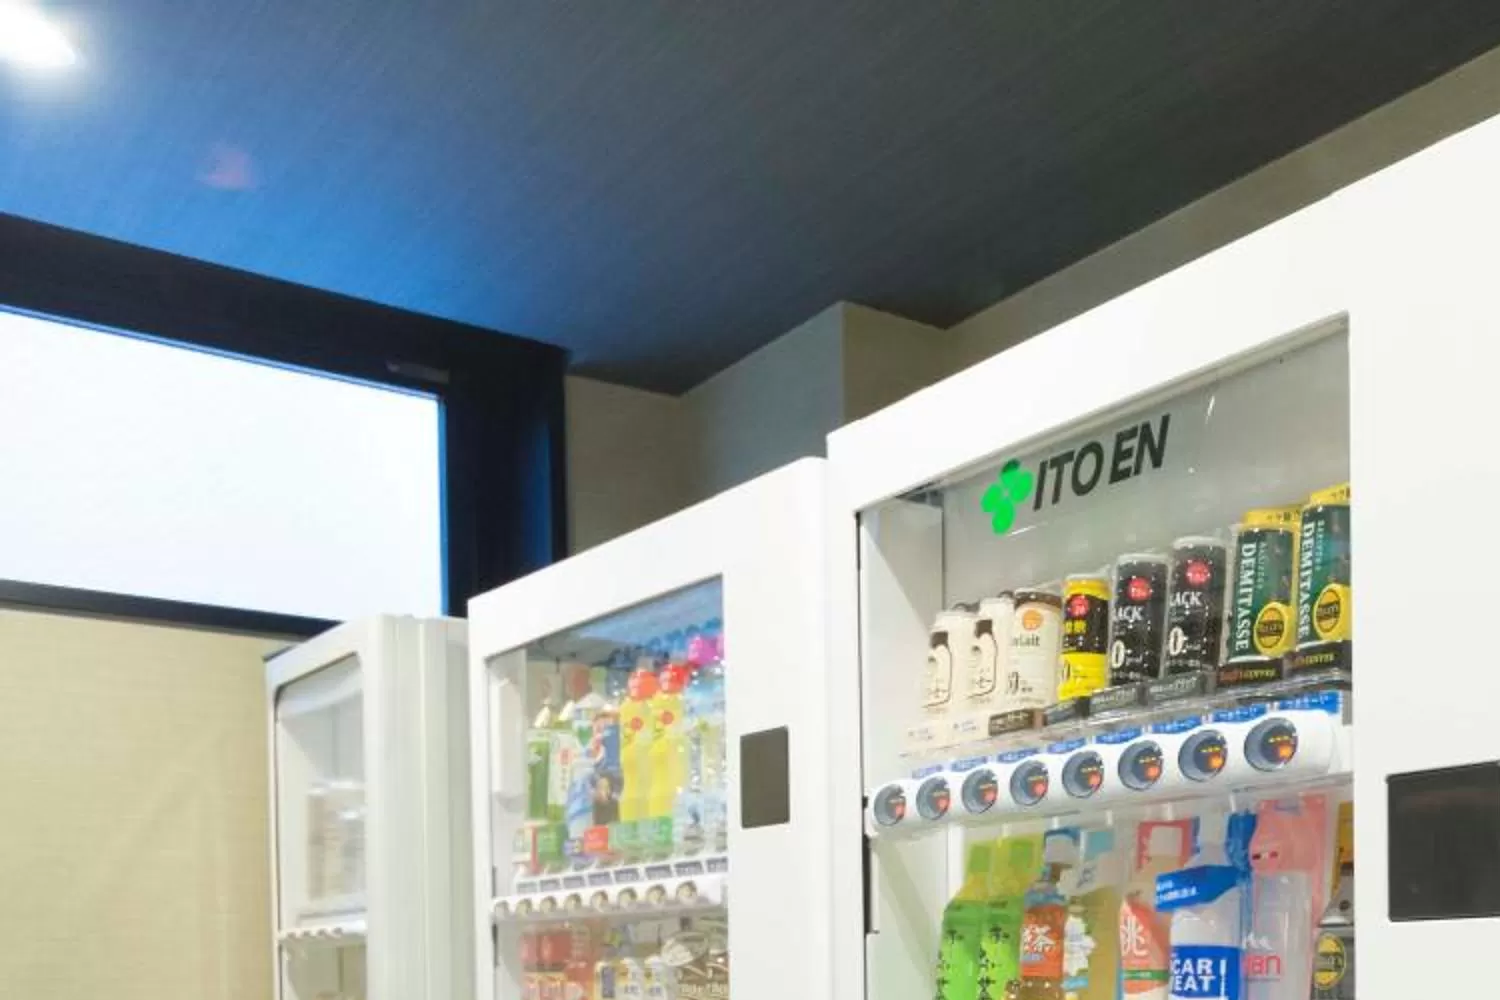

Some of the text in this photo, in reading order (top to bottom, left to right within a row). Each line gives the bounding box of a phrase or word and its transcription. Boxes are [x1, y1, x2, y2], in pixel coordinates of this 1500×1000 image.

[1033, 414, 1170, 511] ITO EN
[1169, 591, 1203, 607] ACK
[1235, 541, 1257, 651] DEMITASSE
[1298, 521, 1315, 638] DEMITASSE
[1113, 605, 1145, 622] ACK
[1172, 975, 1217, 993] EAT
